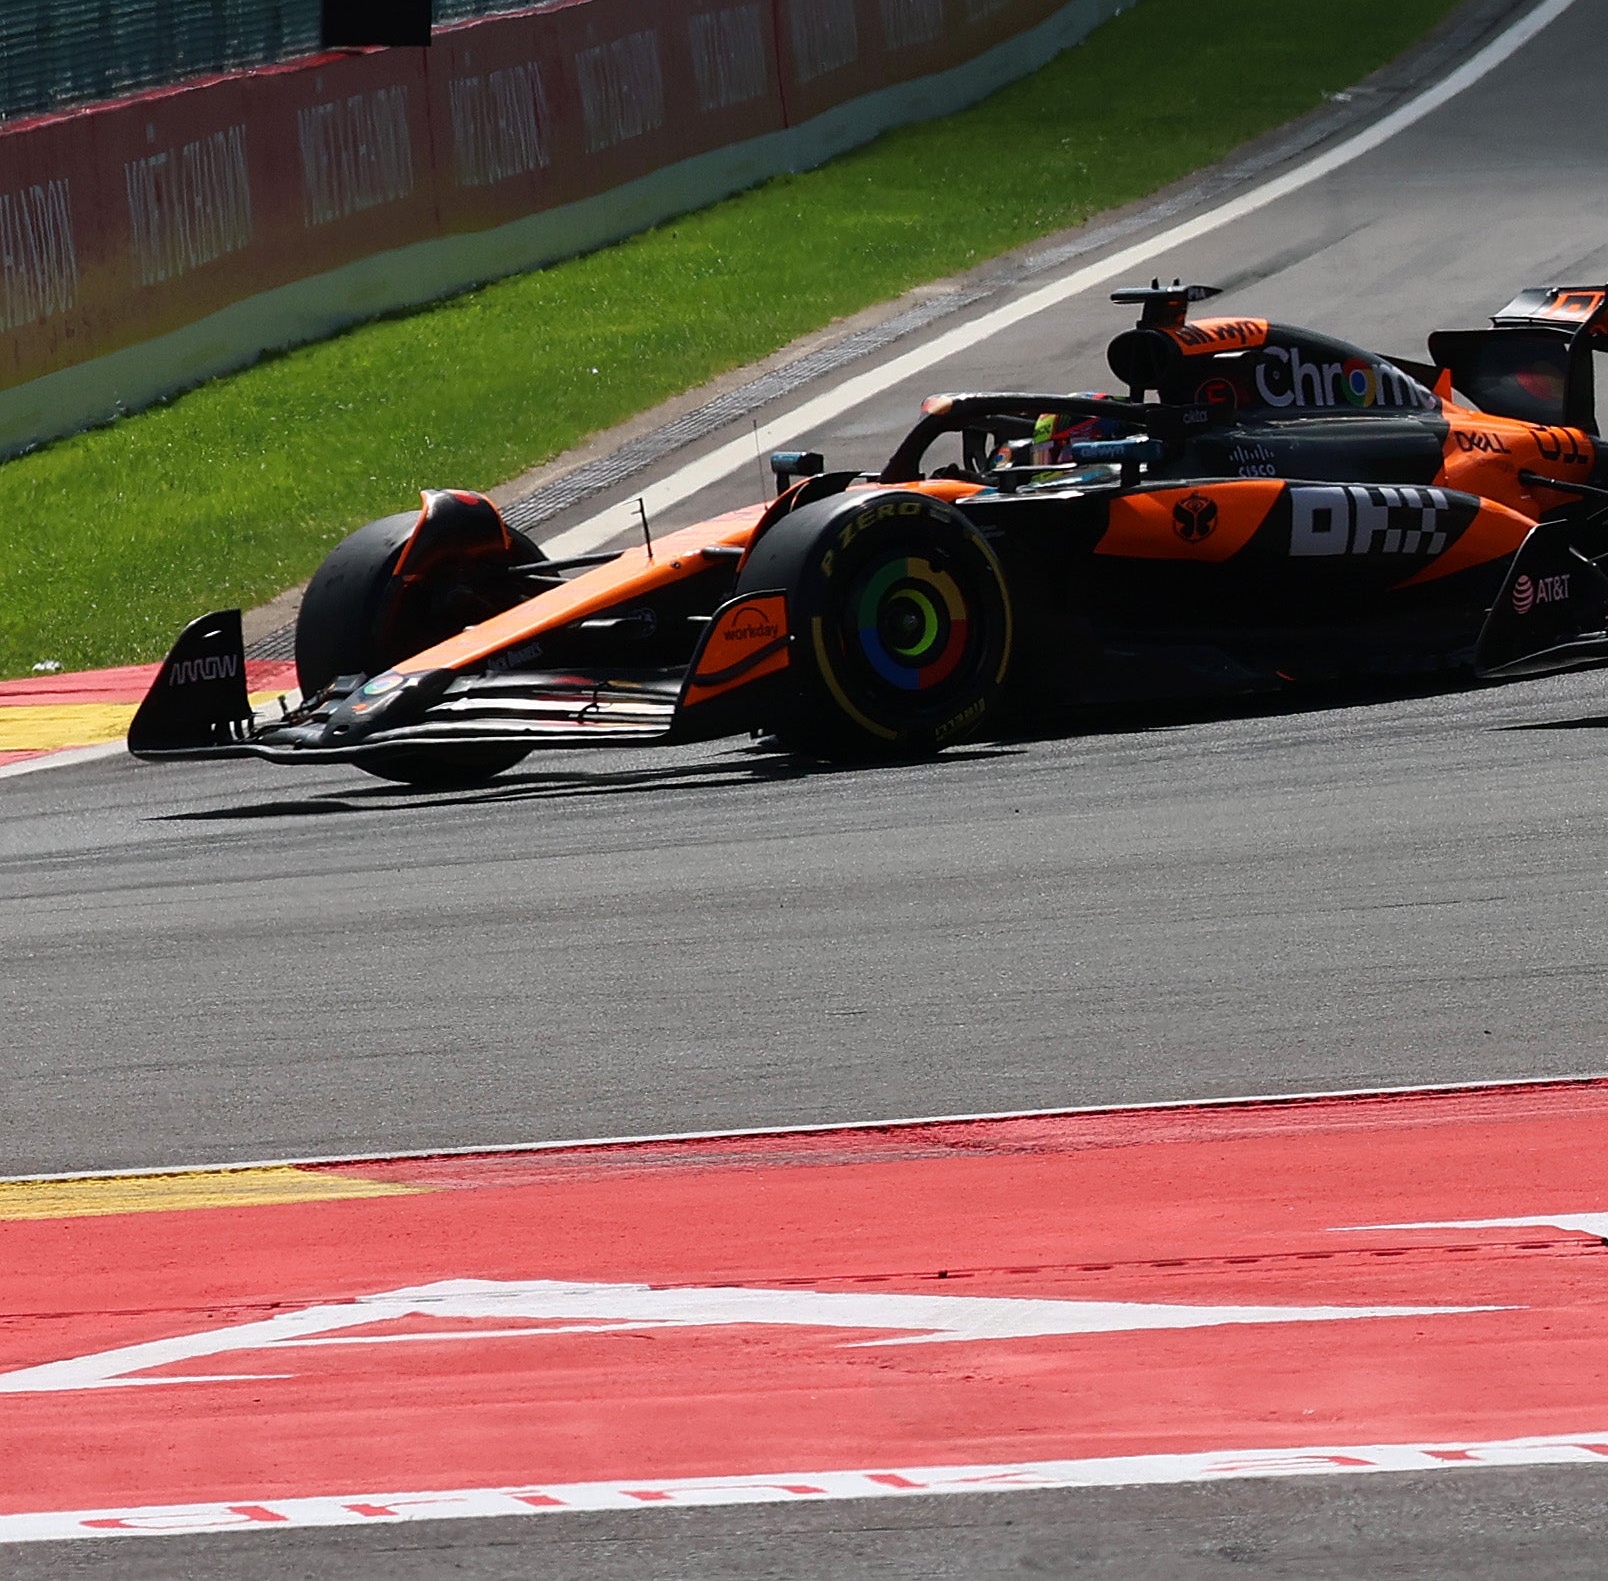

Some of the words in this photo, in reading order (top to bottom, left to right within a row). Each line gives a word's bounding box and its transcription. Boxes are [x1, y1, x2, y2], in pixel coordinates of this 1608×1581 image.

[1238, 462, 1277, 479] cisco
[838, 501, 924, 550] ZERO
[1537, 574, 1571, 603] AT&T
[723, 624, 779, 642] workday
[76, 1468, 1072, 1530] drink
